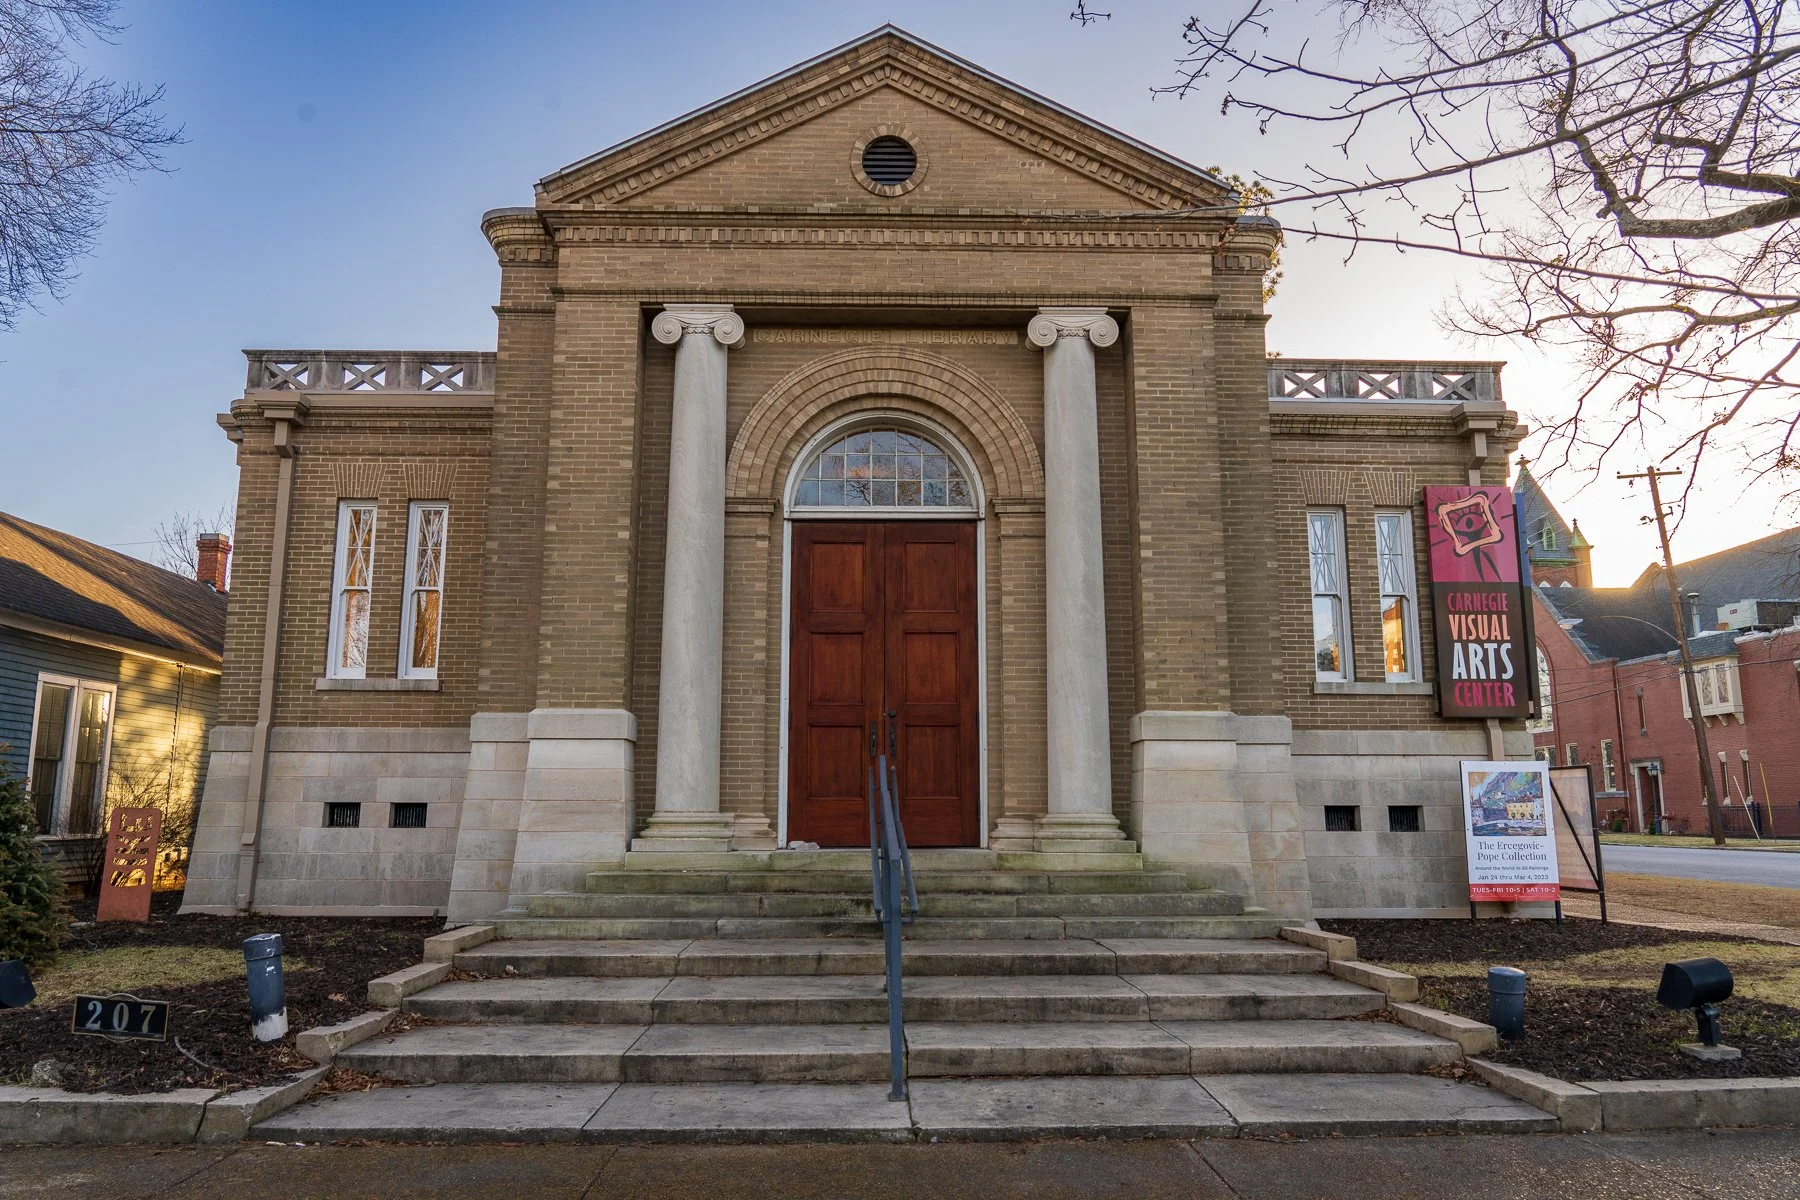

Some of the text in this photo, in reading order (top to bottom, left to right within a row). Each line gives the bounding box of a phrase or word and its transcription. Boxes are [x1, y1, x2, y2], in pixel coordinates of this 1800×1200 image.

[755, 329, 1014, 344] CARNEGIE LIBRARY
[1447, 592, 1508, 612] CARNEGIE
[1448, 614, 1511, 640] VISUAL
[1452, 642, 1514, 680] ARTS
[1454, 682, 1516, 707] CENTER
[1477, 841, 1545, 851] The Ercegovic-
[1477, 852, 1547, 862] Pope Collection
[85, 1000, 157, 1034] 207
